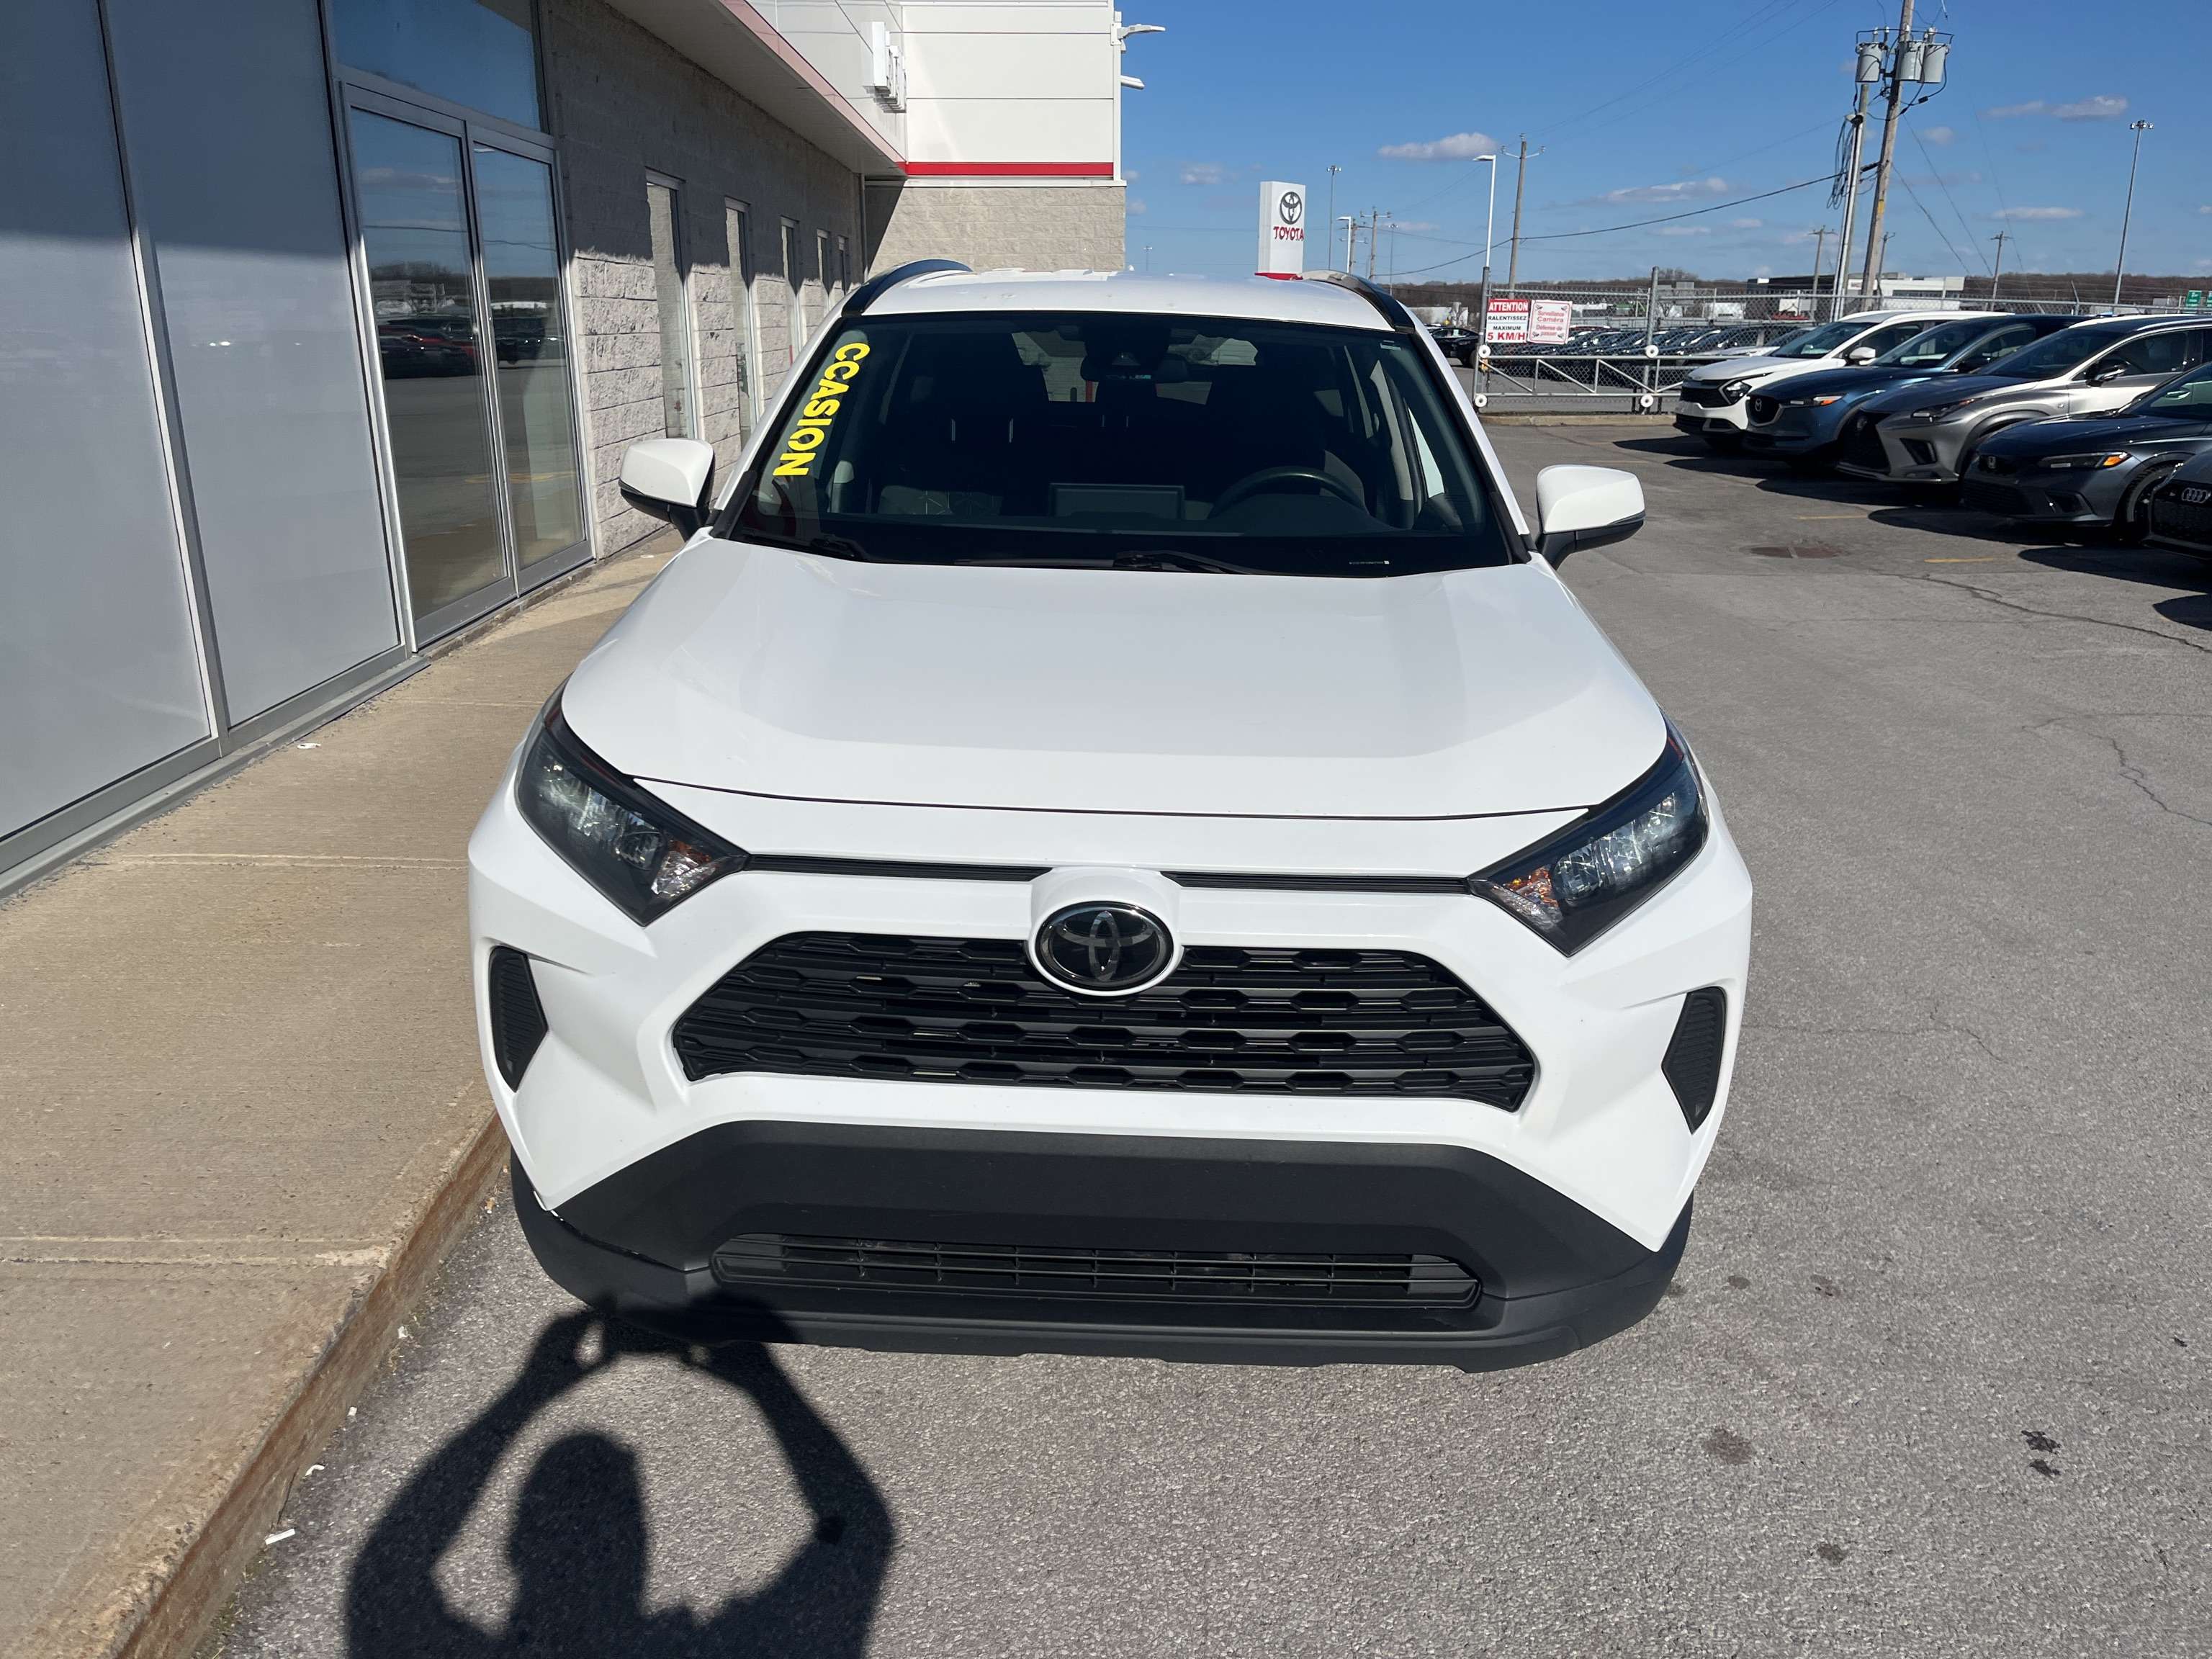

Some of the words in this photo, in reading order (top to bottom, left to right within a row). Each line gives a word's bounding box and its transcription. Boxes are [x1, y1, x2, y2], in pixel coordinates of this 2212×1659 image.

[1273, 226, 1304, 241] TOYOTA
[1488, 301, 1528, 312] ATTENTION
[1487, 332, 1493, 341] 5
[1497, 332, 1526, 341] KM/H
